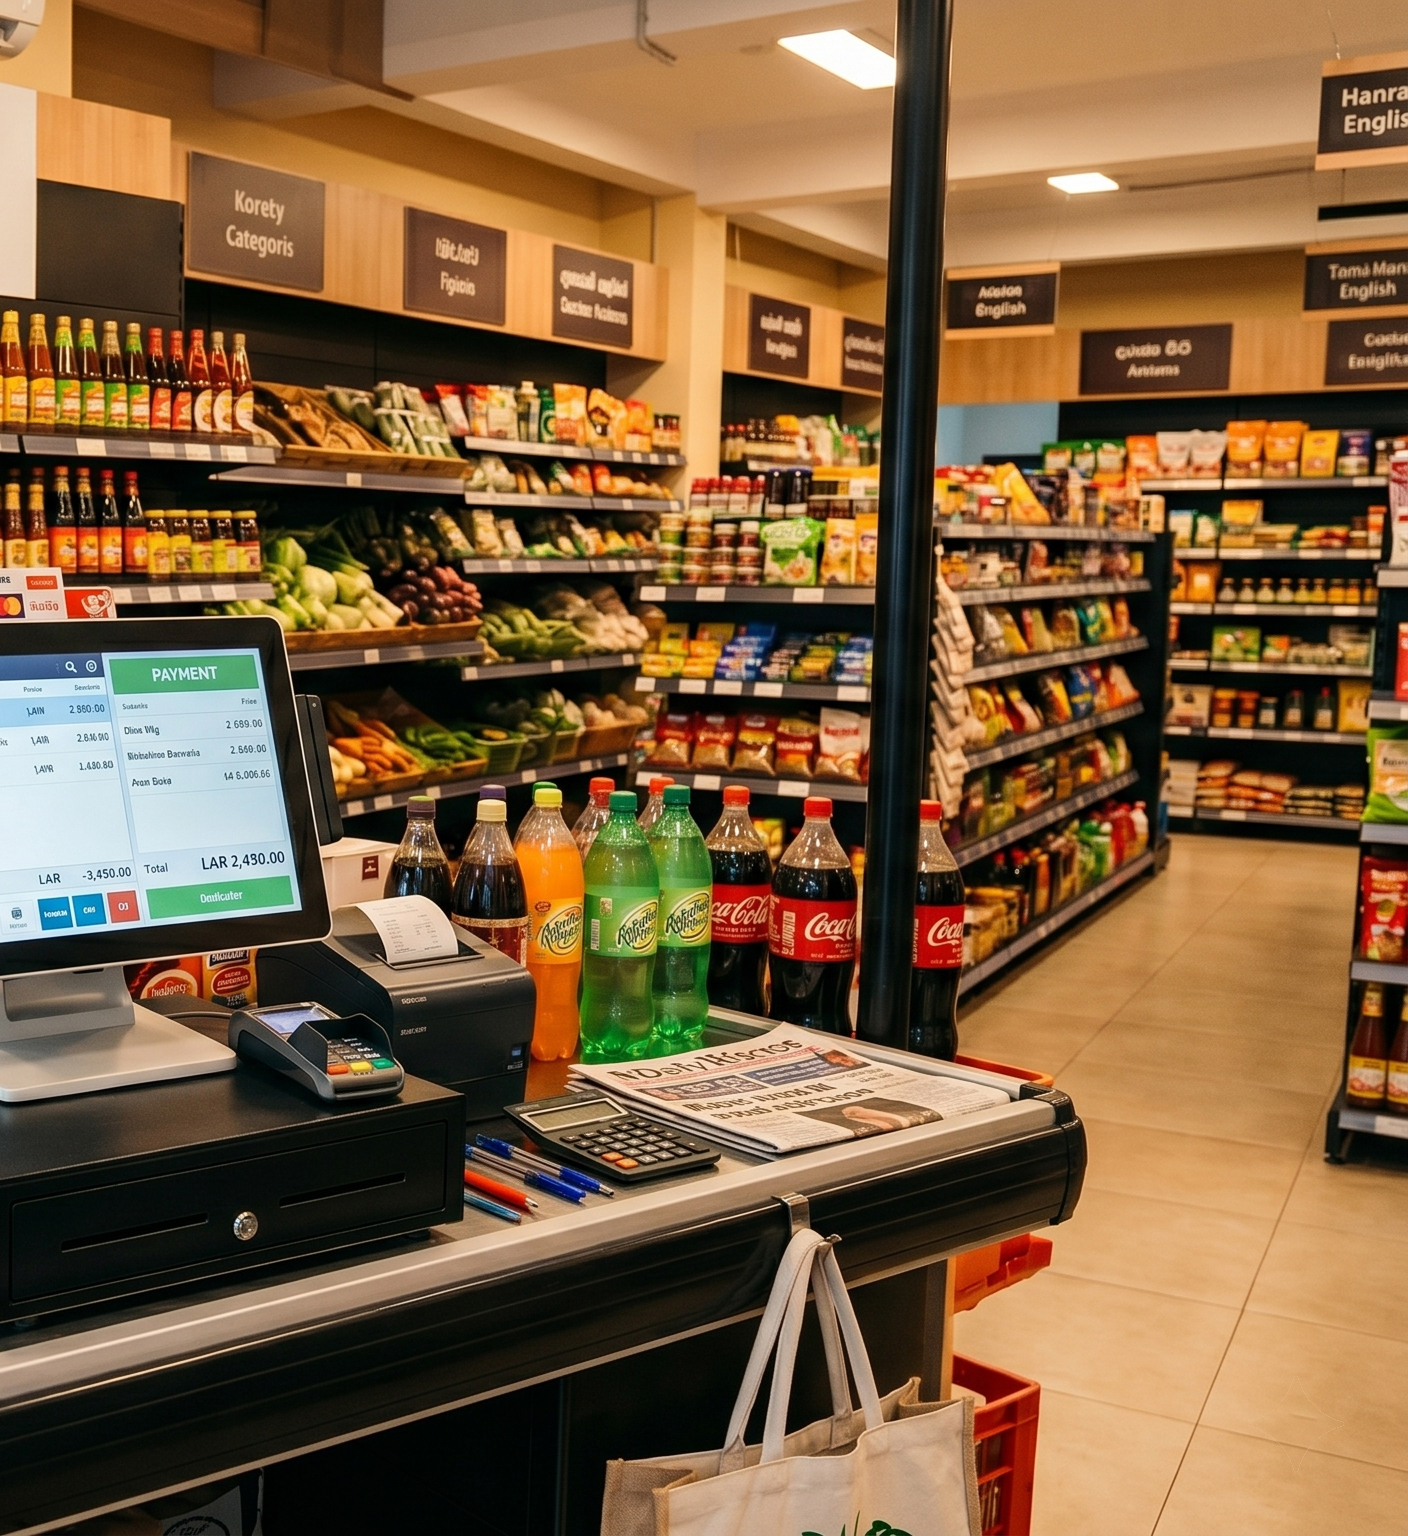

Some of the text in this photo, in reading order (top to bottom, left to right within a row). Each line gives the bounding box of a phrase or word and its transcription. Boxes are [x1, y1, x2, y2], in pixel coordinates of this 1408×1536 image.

[234, 189, 285, 226] Korety
[226, 224, 294, 258] Categoris
[1339, 280, 1397, 302] English
[151, 665, 218, 682] PAYMENT
[144, 862, 168, 874] Total
[201, 855, 228, 870] LAR
[38, 866, 132, 885] LAR -3,450.00
[712, 895, 769, 926] ca-Cola
[804, 911, 857, 942] Coca-C
